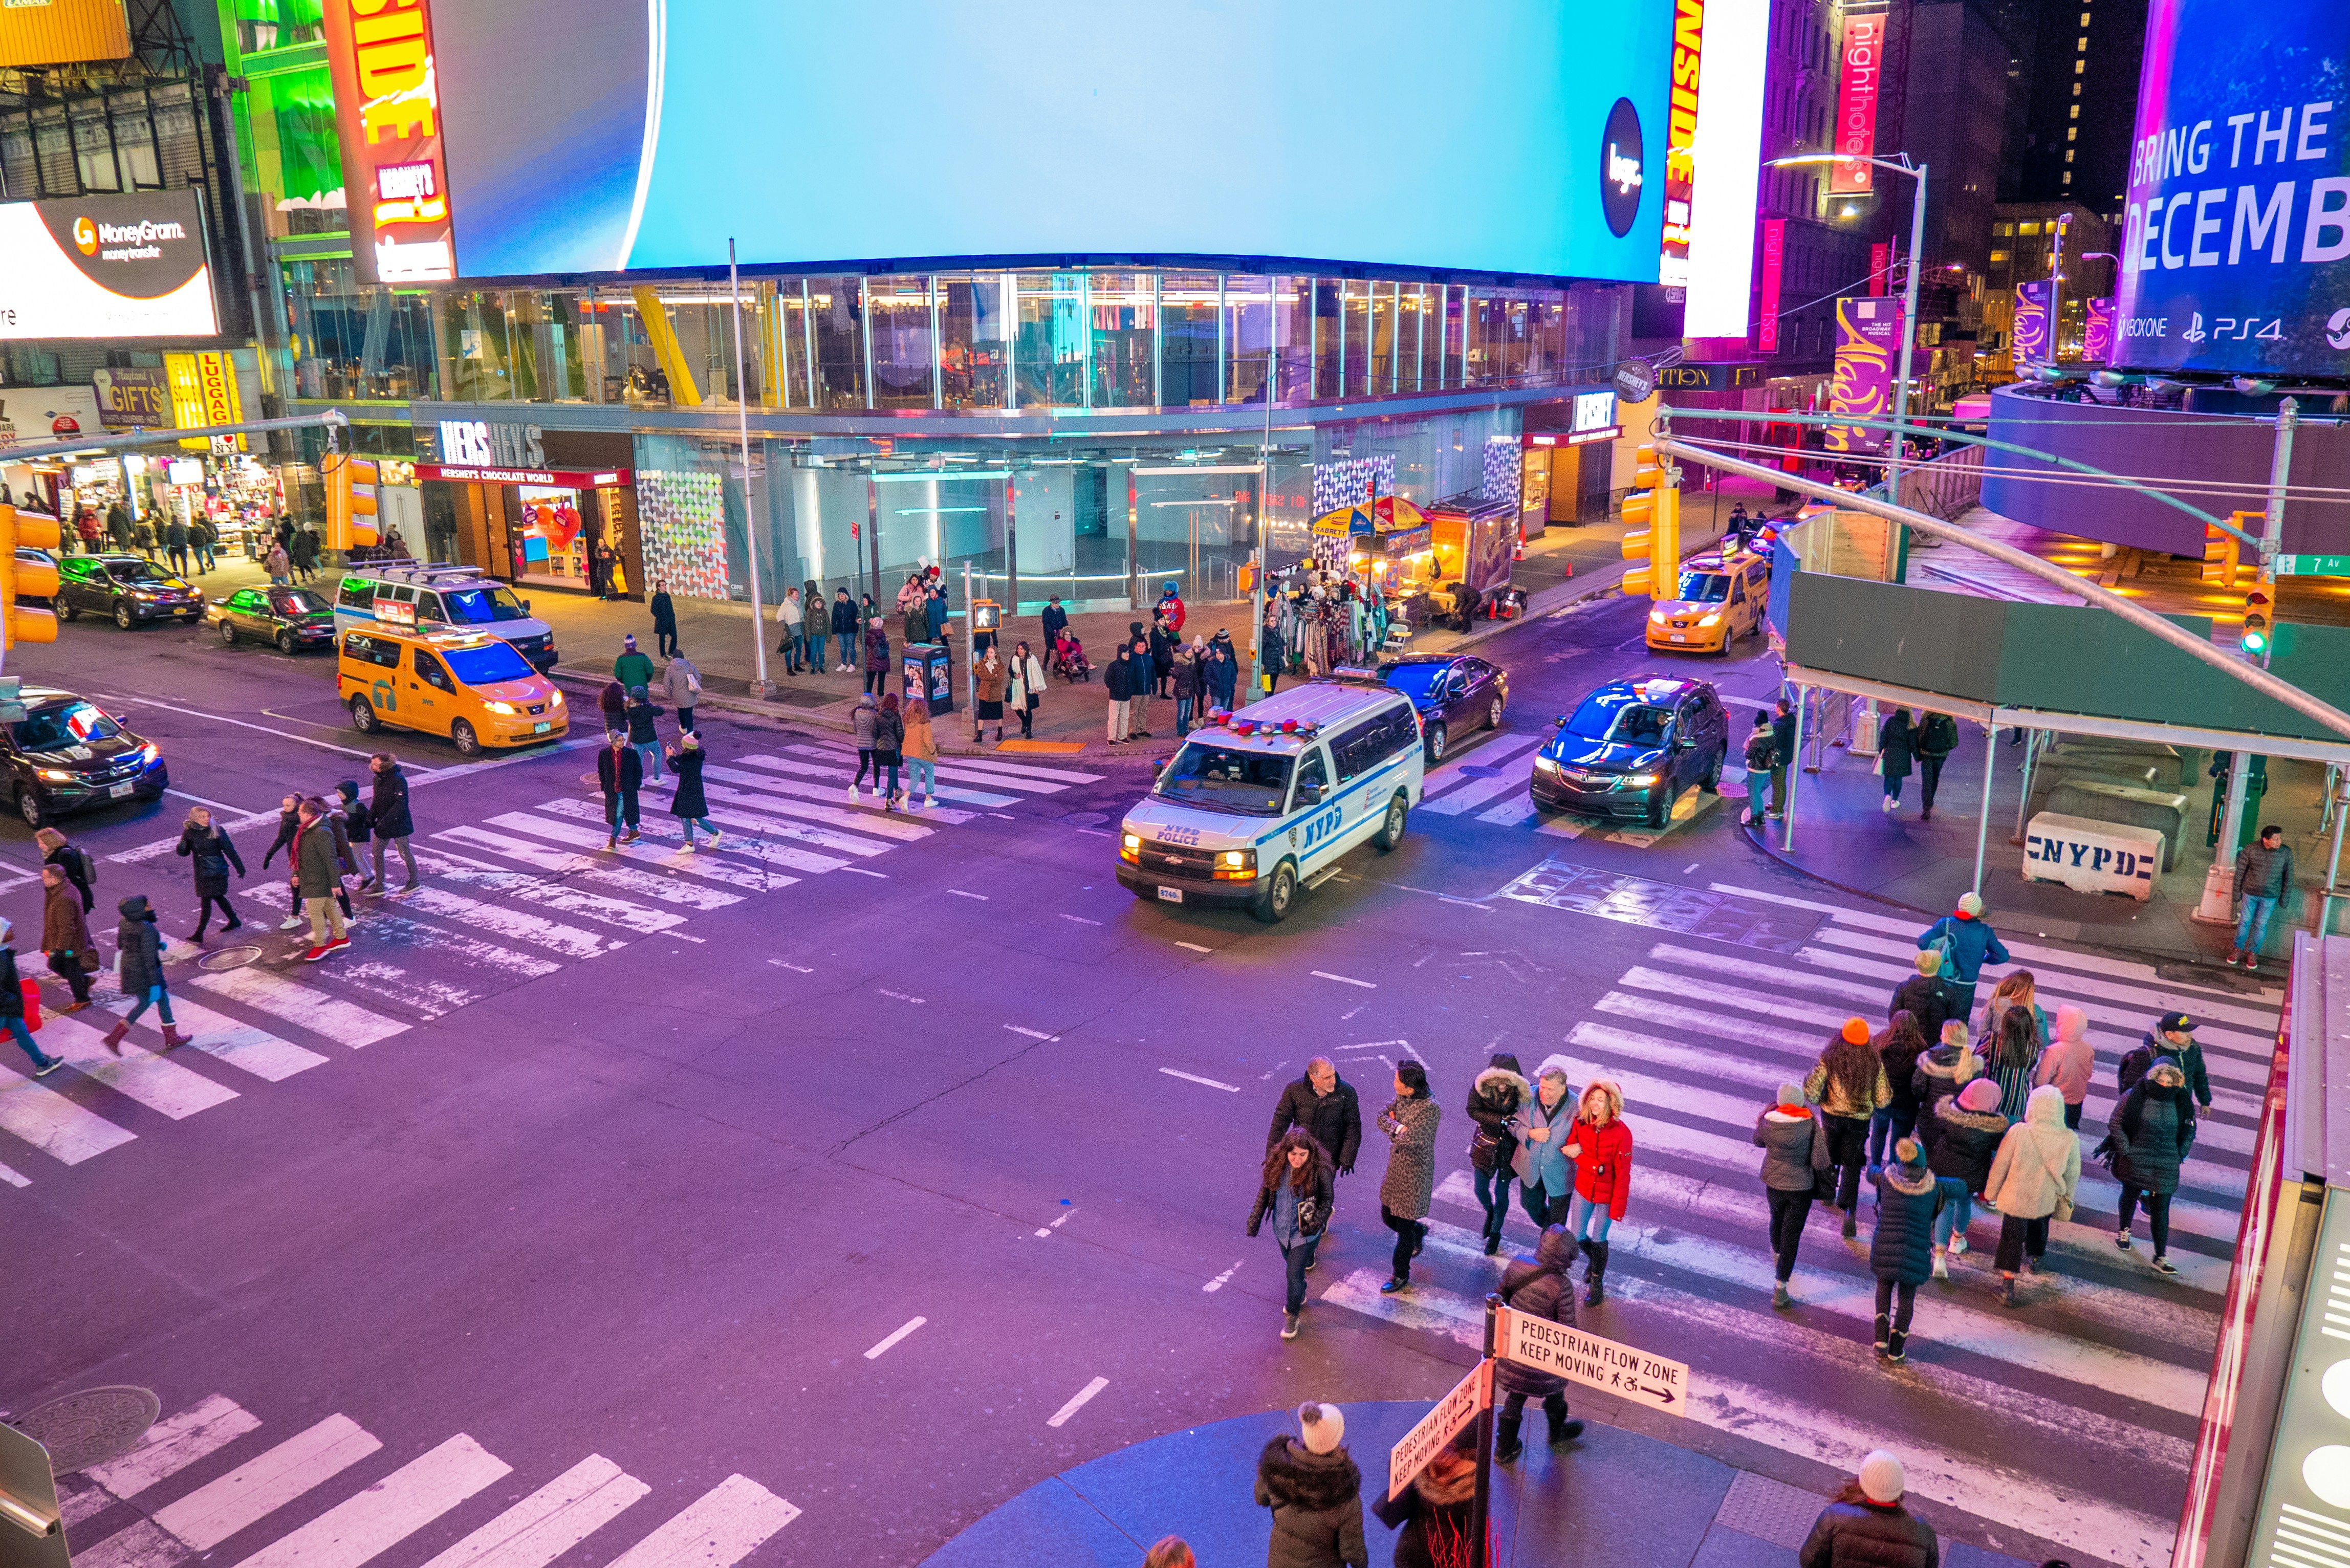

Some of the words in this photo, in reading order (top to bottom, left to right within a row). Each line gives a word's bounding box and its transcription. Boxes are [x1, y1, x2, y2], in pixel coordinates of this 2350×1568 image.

[2133, 120, 2212, 188] BRING
[2227, 101, 2333, 168] THE
[2122, 177, 2350, 273] DECEMB
[2125, 318, 2145, 338] XBOX
[2143, 318, 2168, 337] ONE
[2213, 318, 2282, 340] PS4
[205, 355, 227, 425] LUGGAG
[226, 360, 237, 402] LOWEST
[1659, 368, 1709, 386] ITION
[109, 385, 163, 413] GIFTS
[234, 406, 246, 448] PRES
[440, 420, 545, 469] HERSHEY'S
[215, 444, 235, 454] NY
[441, 468, 479, 480] HERSHEY'S
[481, 470, 526, 483] CHOCOLATE
[527, 472, 554, 484] WORLD
[1315, 526, 1346, 536] SABRETT
[2314, 558, 2321, 572] 7
[1157, 831, 1200, 846] POLICE
[1164, 824, 1201, 836] NYPD
[1303, 806, 1342, 849] NYPD
[2041, 838, 2136, 876] NYPD
[1520, 1340, 1552, 1362] KEEP
[1555, 1352, 1604, 1382] MOVING
[1521, 1320, 1600, 1359] PEDESTRIAN
[1603, 1347, 1640, 1371] FLOW
[1643, 1359, 1679, 1385] ZONE
[1395, 1417, 1438, 1467] PEDESTRIAN
[1439, 1396, 1458, 1425] FLOW
[1459, 1379, 1476, 1402] ZONE
[1394, 1462, 1412, 1489] KEEP
[1414, 1436, 1440, 1470] MOVING
